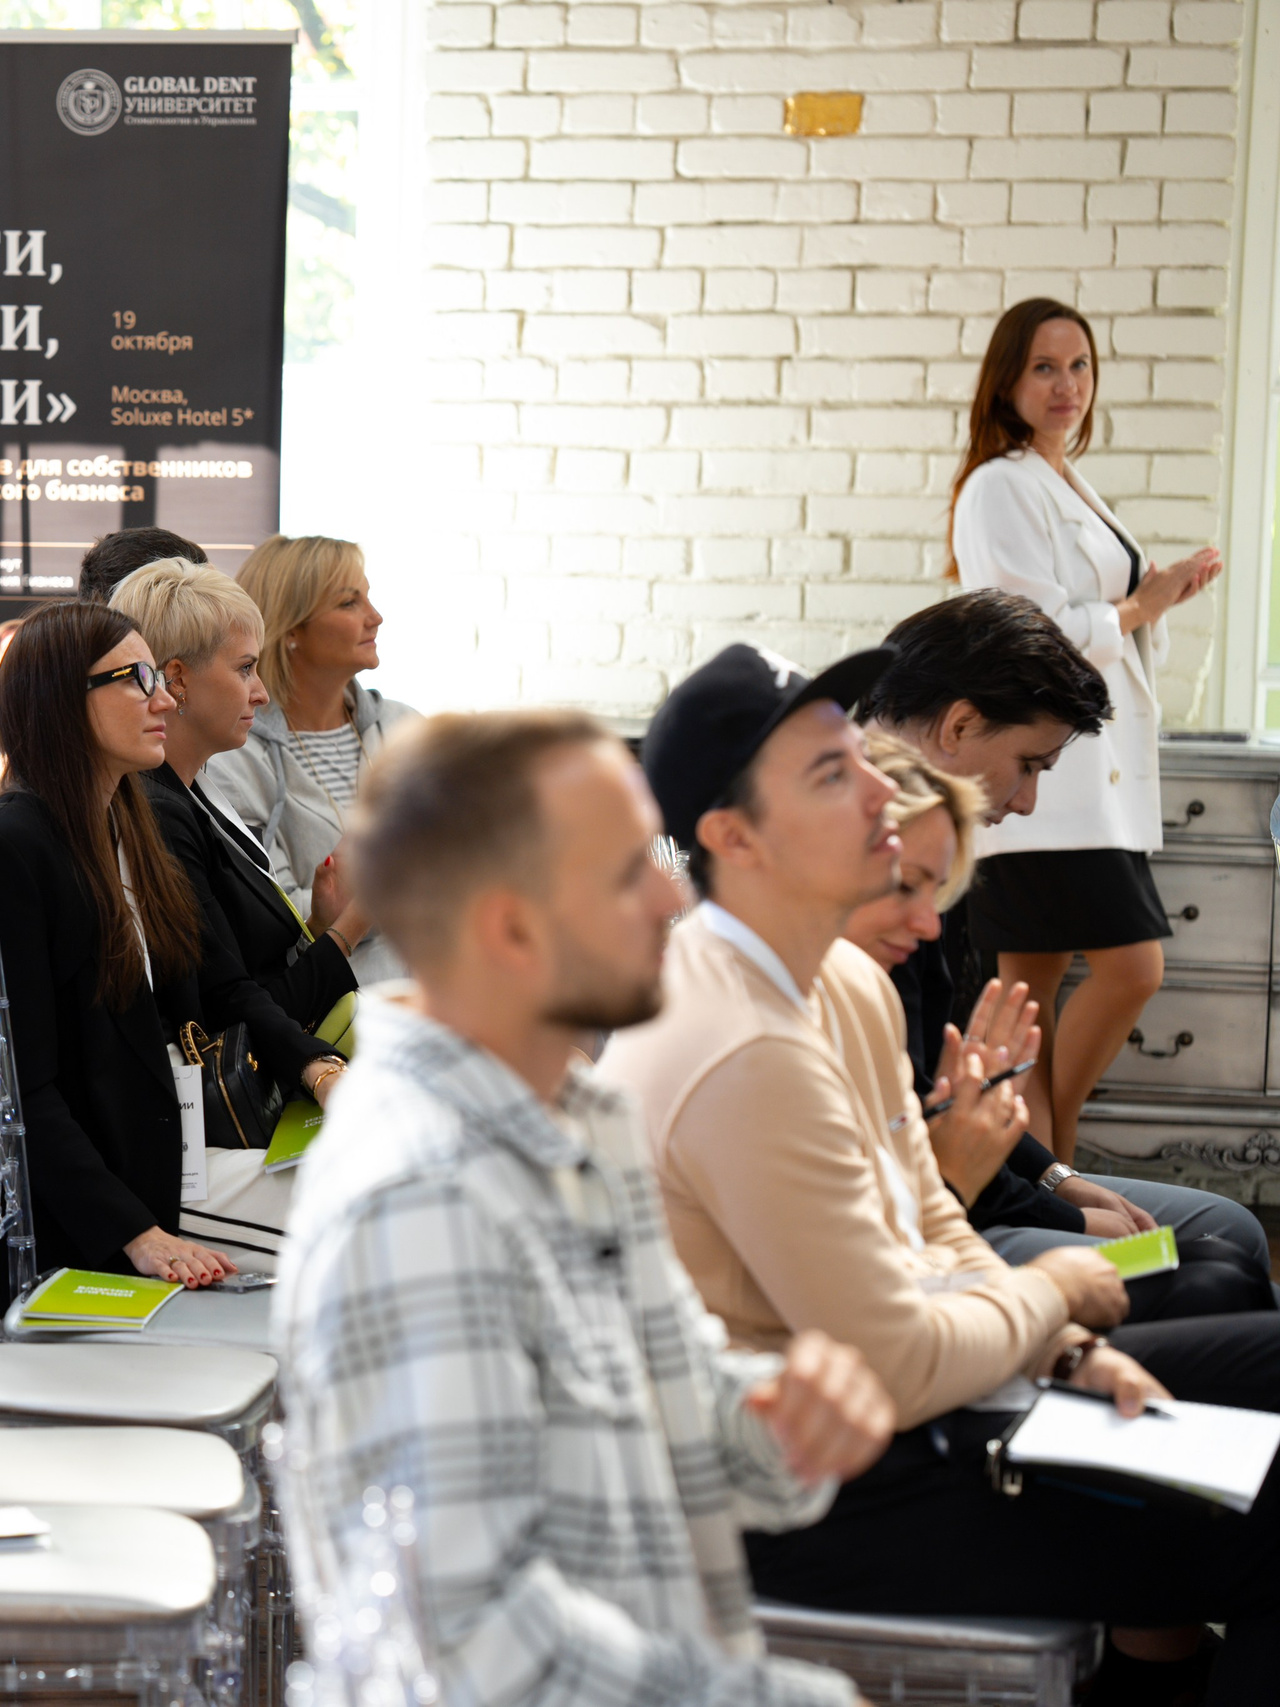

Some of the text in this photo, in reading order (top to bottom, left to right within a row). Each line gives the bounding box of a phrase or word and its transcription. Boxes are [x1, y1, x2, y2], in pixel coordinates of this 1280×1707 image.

[124, 76, 257, 94] GLOBAL DENT
[124, 96, 257, 114] УНИВЕРСИТЕТ
[112, 311, 136, 330] 19
[111, 331, 193, 354] октября
[111, 385, 188, 408] Москва,
[111, 407, 172, 427] Soluxe
[177, 407, 227, 427] Hotel
[17, 455, 64, 480] для
[66, 455, 253, 479] собственников
[45, 478, 145, 503] бизнеса
